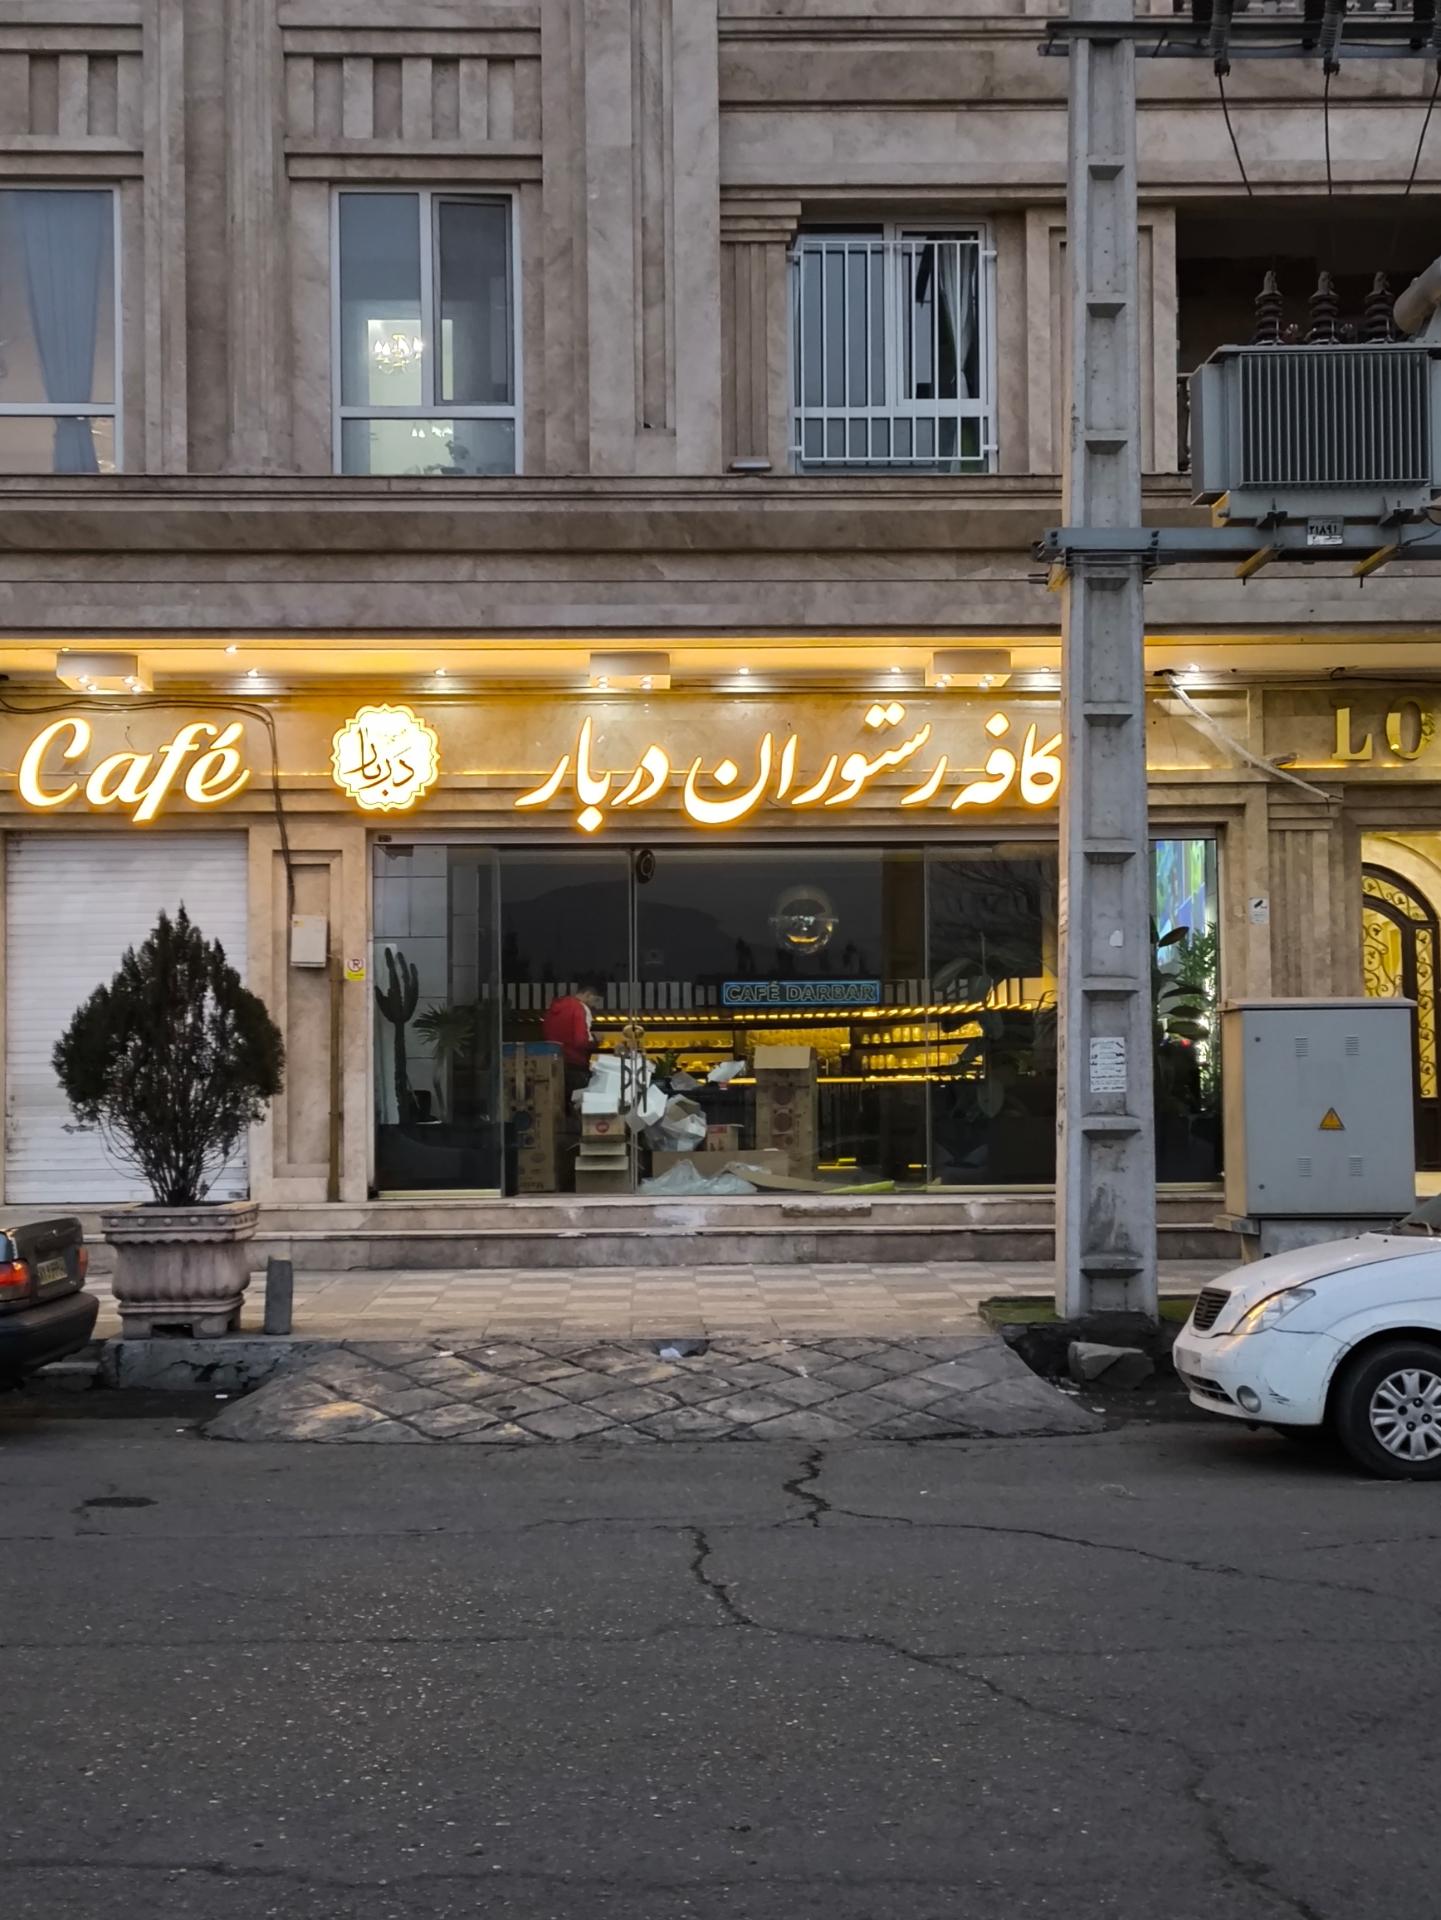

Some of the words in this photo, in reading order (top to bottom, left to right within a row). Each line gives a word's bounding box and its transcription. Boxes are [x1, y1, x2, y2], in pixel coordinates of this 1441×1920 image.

[17, 717, 251, 824] Café
[514, 715, 670, 833] دربار
[682, 702, 949, 825] رستوران
[727, 980, 780, 1001] CAFÉ
[786, 984, 874, 1001] DARBAR
